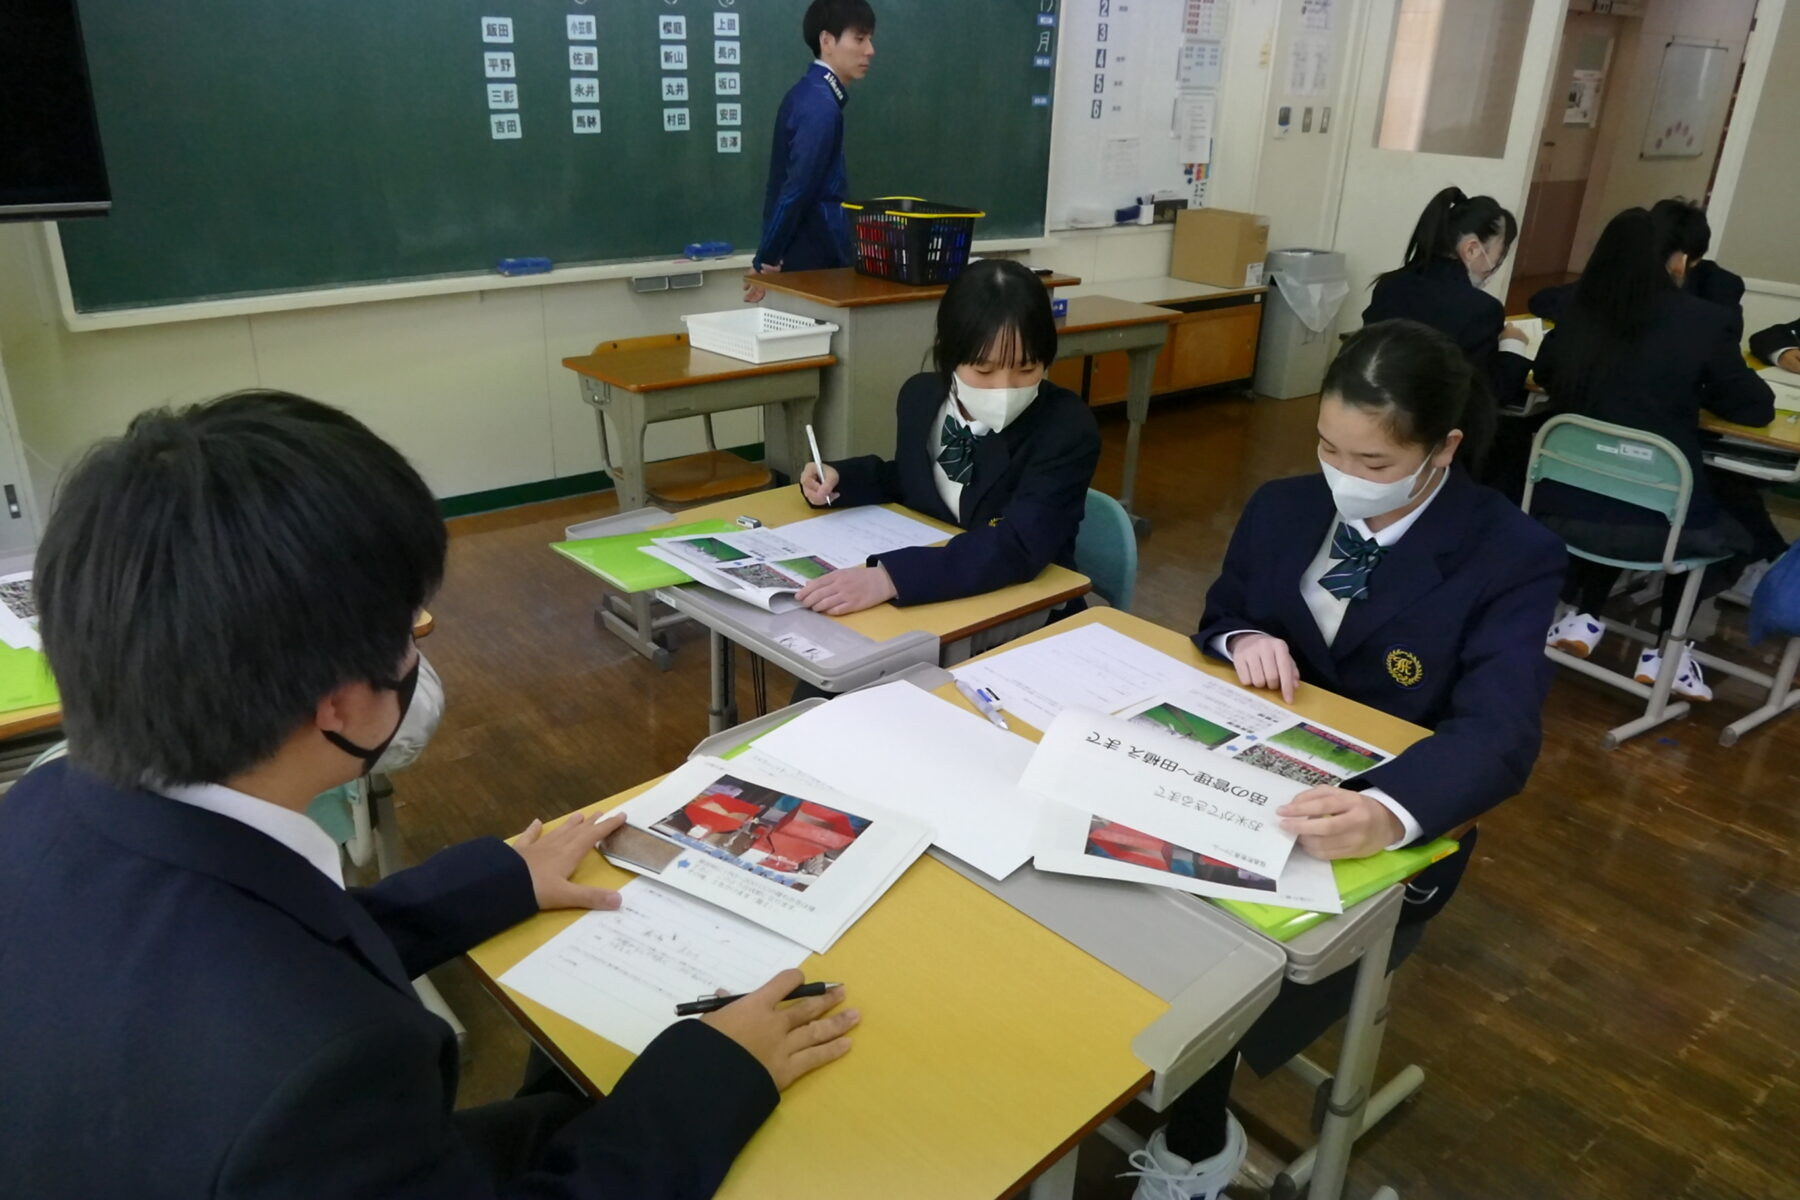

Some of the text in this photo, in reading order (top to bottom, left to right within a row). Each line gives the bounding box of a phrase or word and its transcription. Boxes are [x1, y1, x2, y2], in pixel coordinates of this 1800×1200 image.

[486, 23, 509, 37] 飯田
[717, 18, 736, 31] 上田
[1098, 24, 1107, 41] 3
[1036, 30, 1050, 53] 月
[663, 51, 684, 64] 新山
[1096, 49, 1106, 68] 4
[488, 58, 511, 72] 平野
[574, 83, 595, 97] 永井
[665, 82, 685, 96] 丸井
[1094, 75, 1104, 93] 5
[719, 108, 738, 121] 安田
[1092, 100, 1101, 118] 6
[494, 119, 517, 134] 吉田
[666, 113, 686, 126] 村田
[1153, 784, 1266, 834] お米ができるまで
